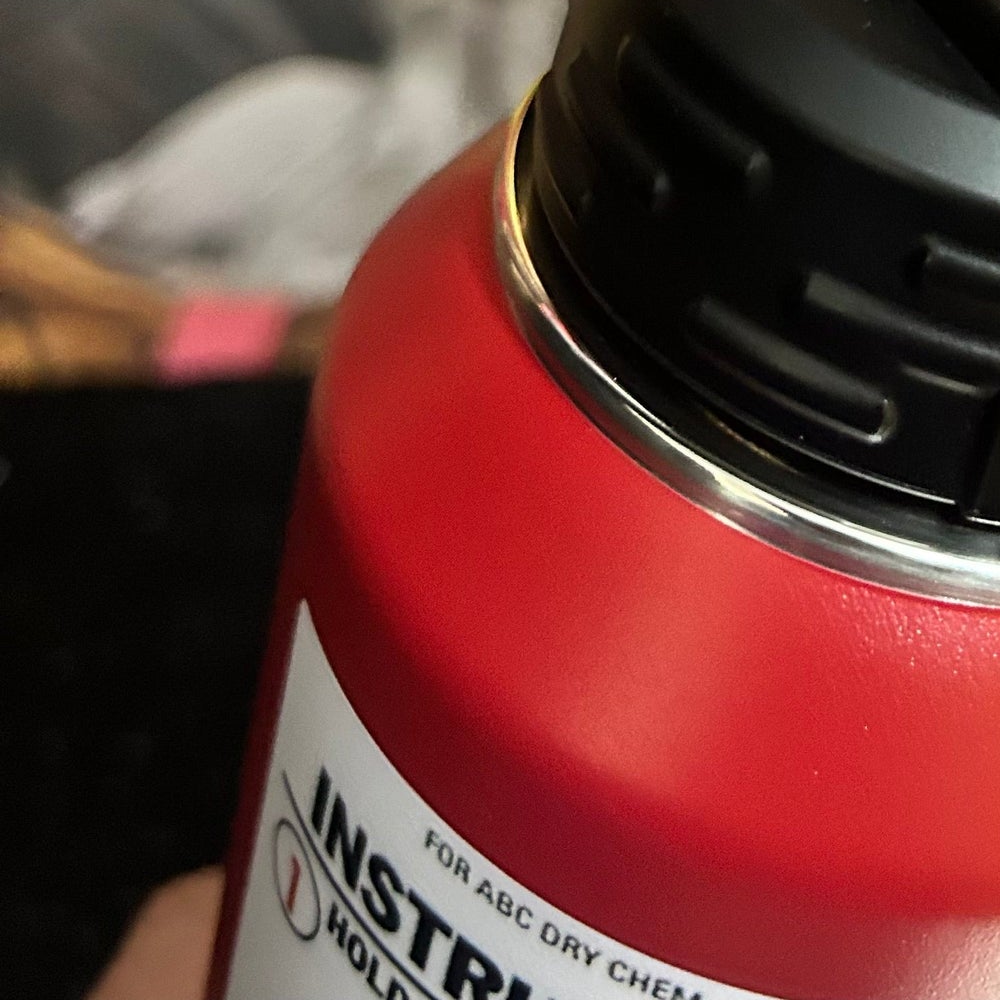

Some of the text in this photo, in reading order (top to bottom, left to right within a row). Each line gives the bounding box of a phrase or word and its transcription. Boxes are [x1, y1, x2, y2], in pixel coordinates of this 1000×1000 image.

[311, 765, 553, 1000] INSTR
[424, 829, 471, 884] FOR
[475, 878, 534, 930] ABC
[540, 921, 600, 966] DRY
